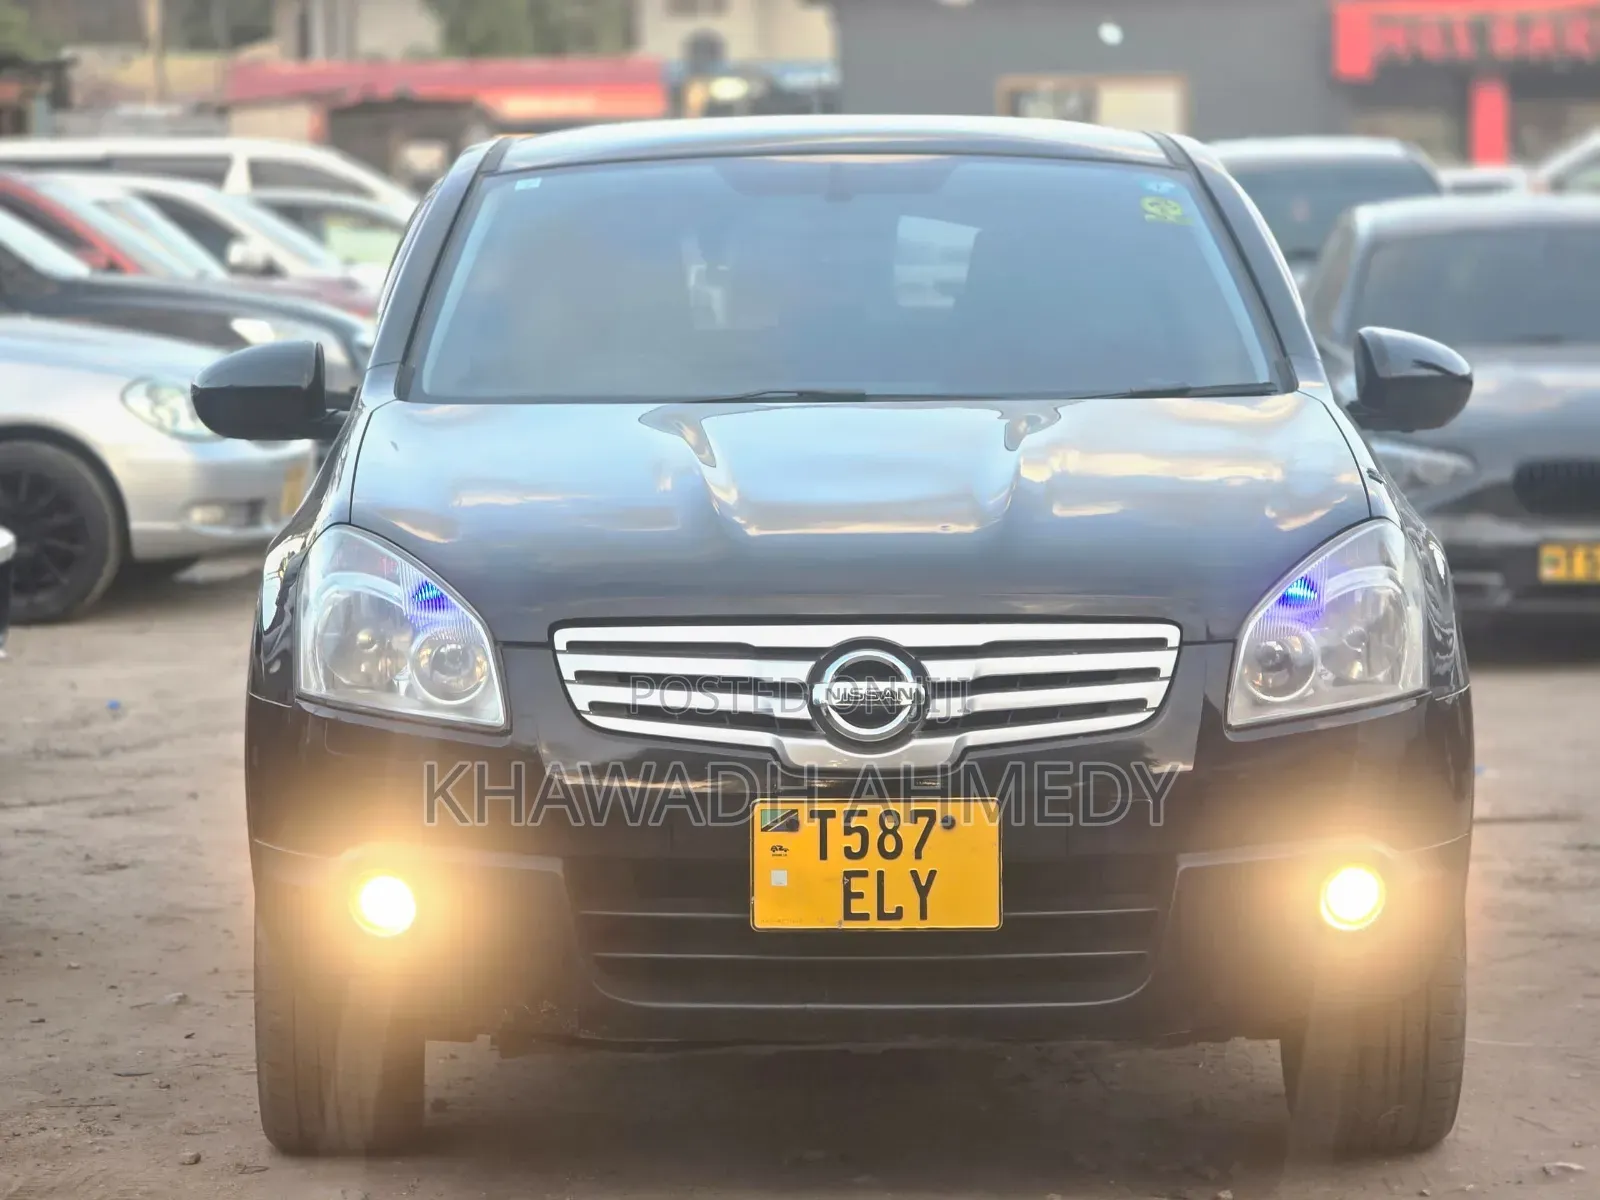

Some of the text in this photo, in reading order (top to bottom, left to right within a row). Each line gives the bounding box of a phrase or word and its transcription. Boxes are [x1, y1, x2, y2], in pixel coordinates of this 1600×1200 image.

[824, 686, 914, 702] NISSAN
[809, 808, 937, 862] T587
[842, 868, 938, 922] ELY
